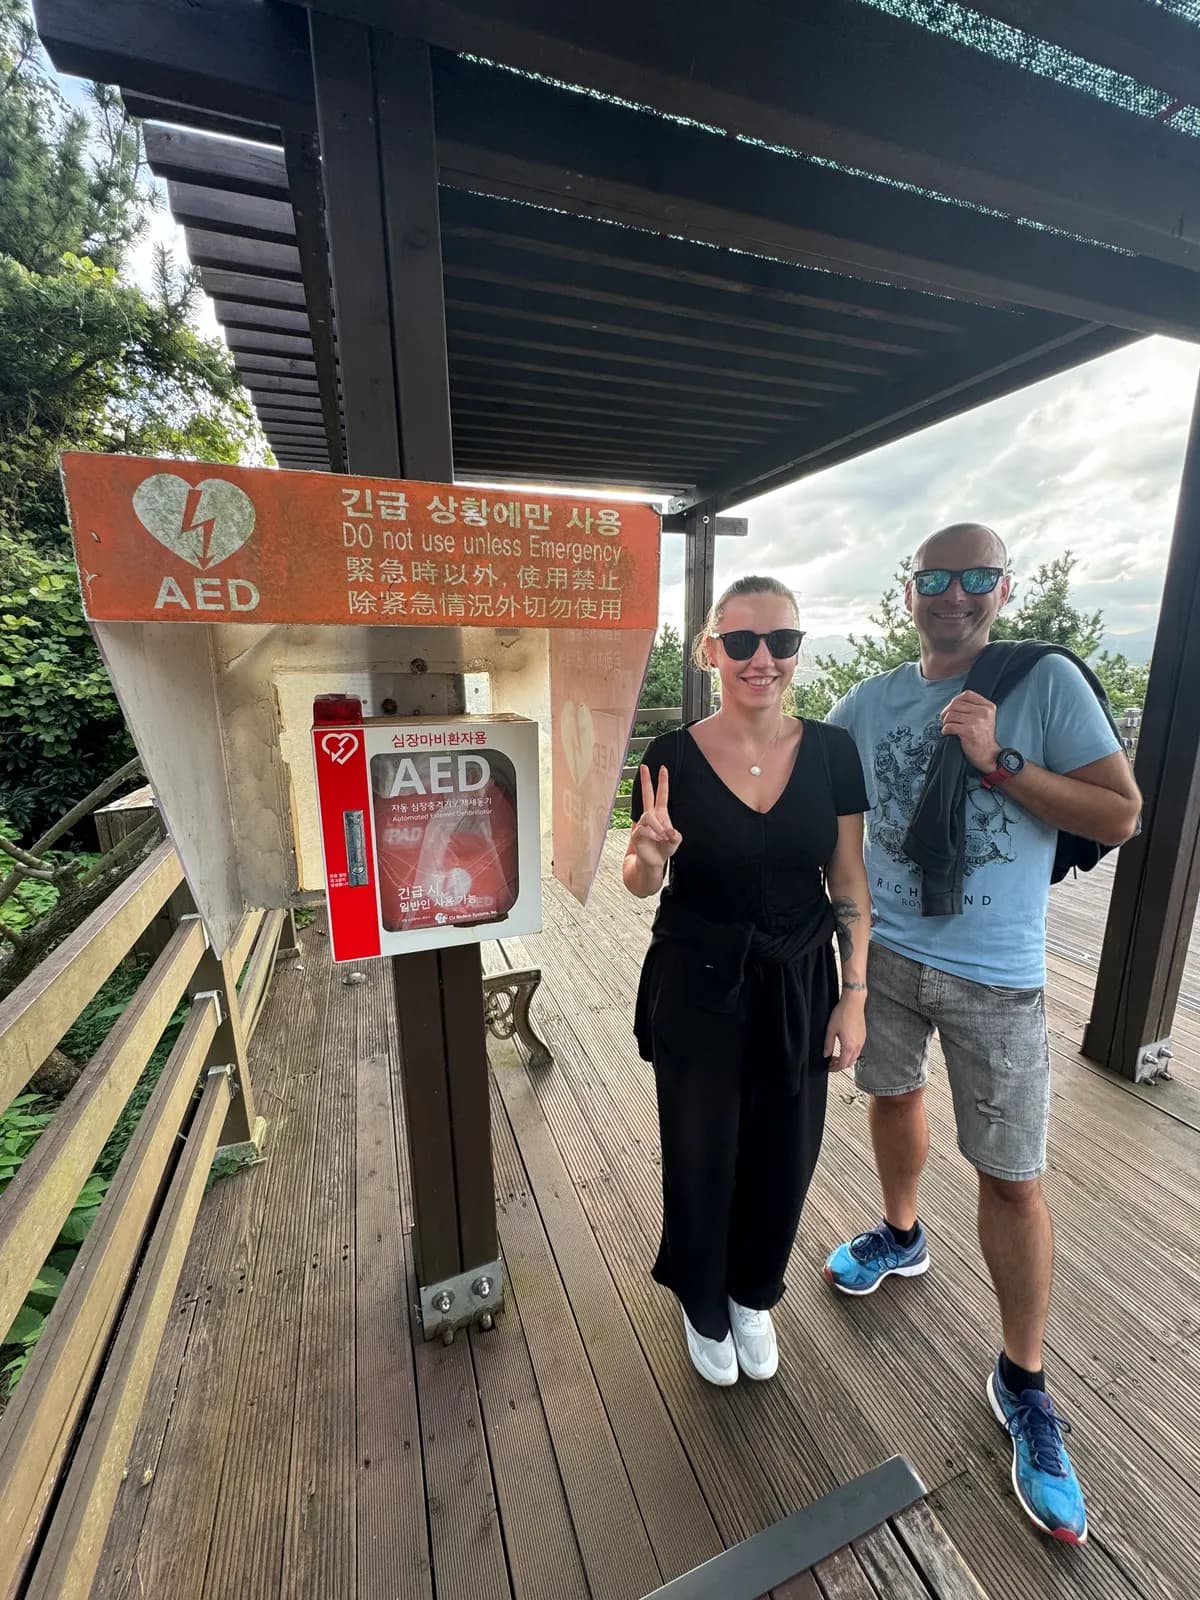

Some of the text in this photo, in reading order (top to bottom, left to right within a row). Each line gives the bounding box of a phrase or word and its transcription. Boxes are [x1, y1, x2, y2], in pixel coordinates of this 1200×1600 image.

[341, 488, 622, 537] 긴급 상황에만 사용
[343, 522, 622, 566] DO not use unless Emergency
[154, 576, 260, 612] AED
[391, 731, 488, 749] 심장마비환자용
[389, 754, 491, 799] AED
[392, 803, 409, 813] 자동
[392, 813, 429, 823] Automated
[398, 885, 424, 900] 긴급
[876, 878, 992, 906] RICHND
[400, 899, 431, 912] 일반인
